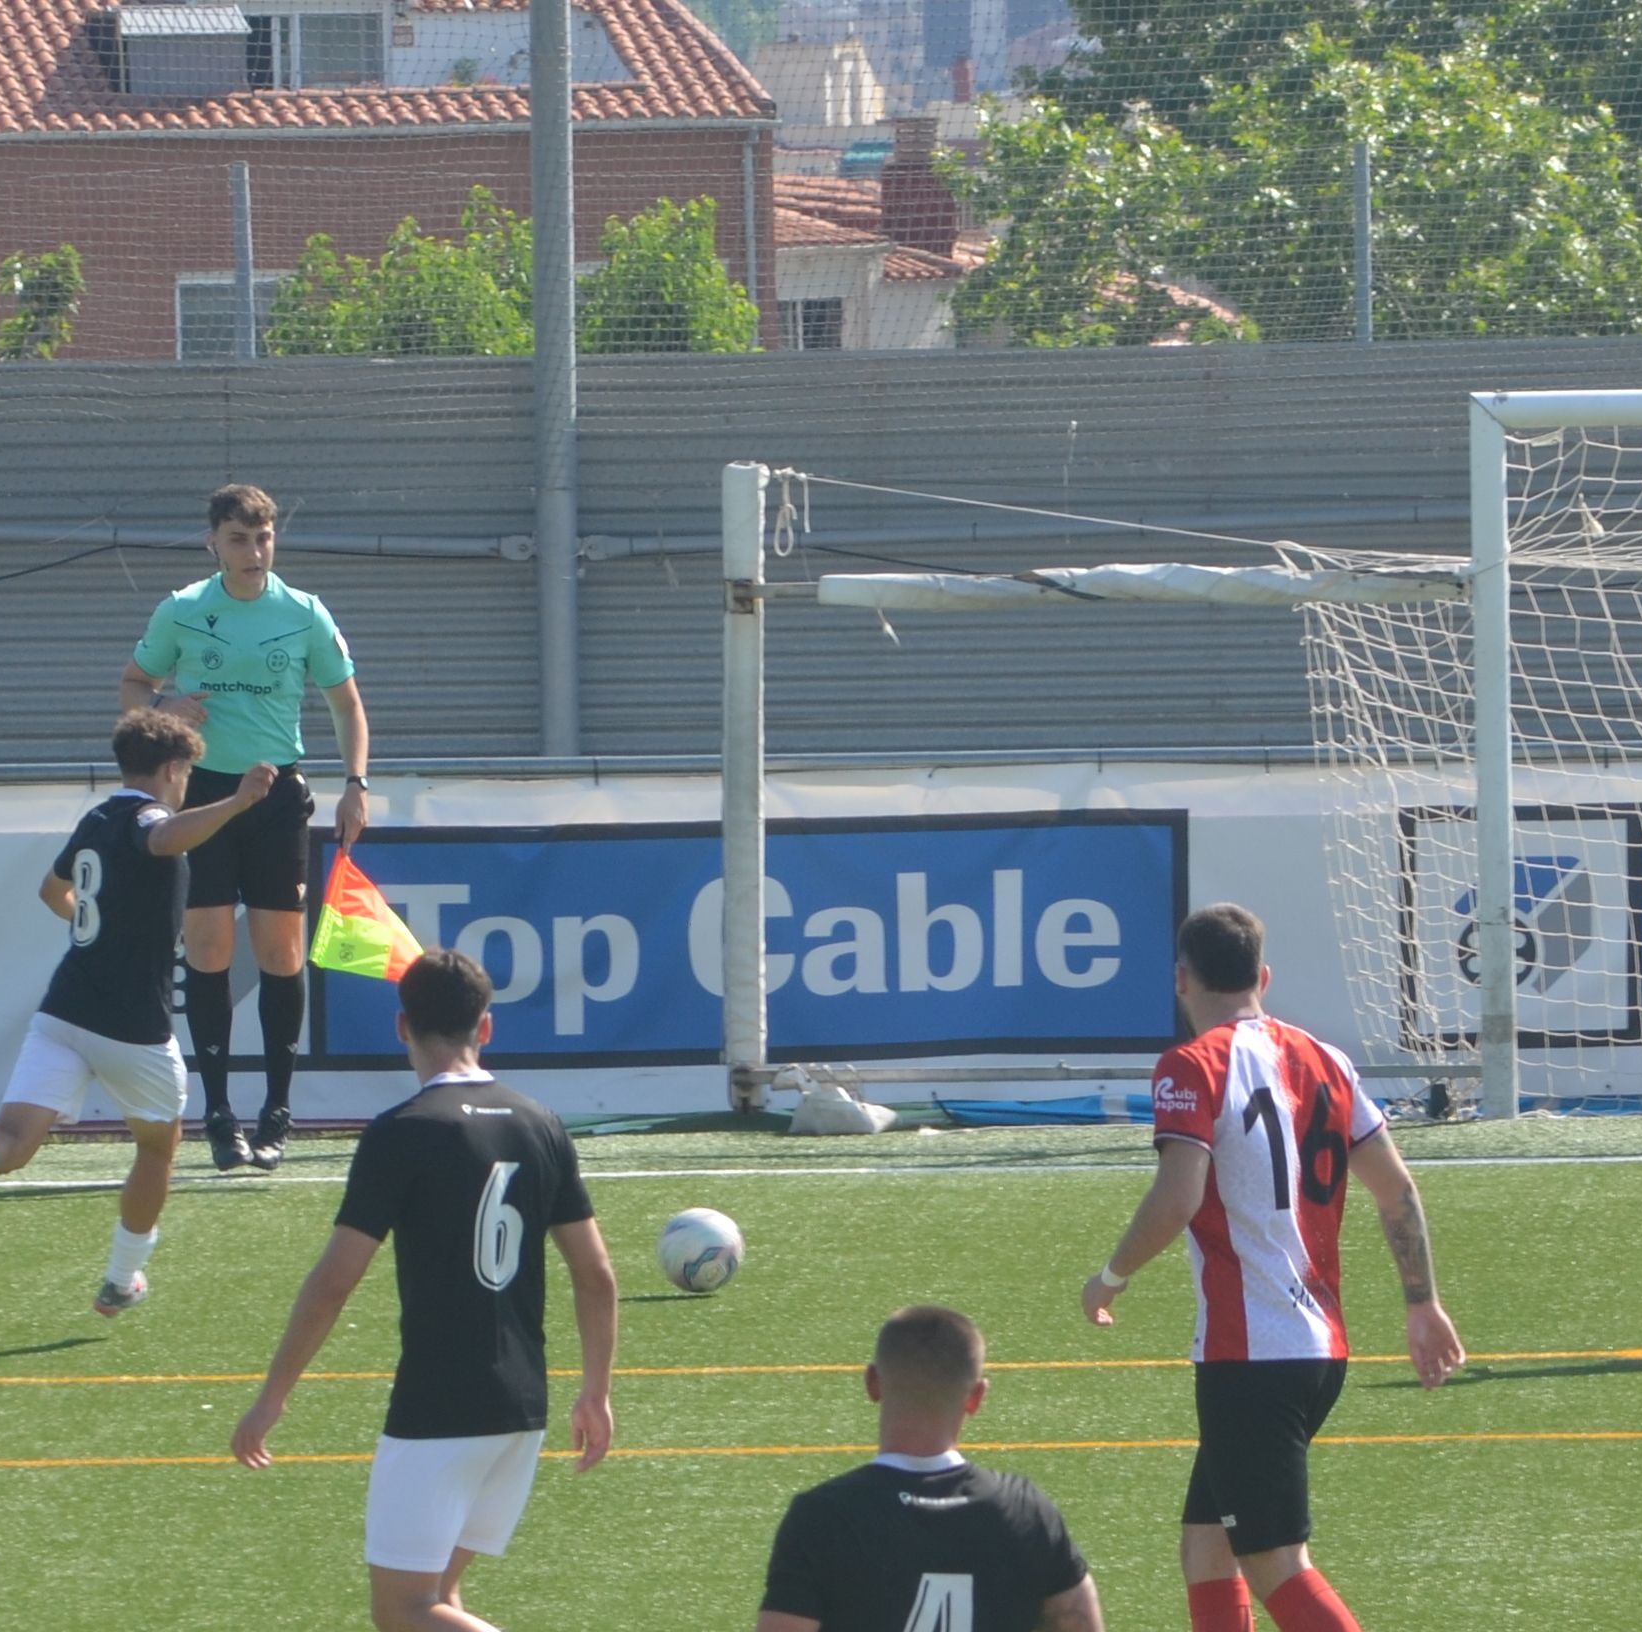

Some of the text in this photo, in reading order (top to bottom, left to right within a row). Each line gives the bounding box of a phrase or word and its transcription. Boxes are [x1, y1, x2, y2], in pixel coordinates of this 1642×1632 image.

[71, 848, 102, 947] 8
[373, 869, 1121, 1035] Top Cable
[1243, 1082, 1348, 1210] 16
[473, 1161, 524, 1292] 6
